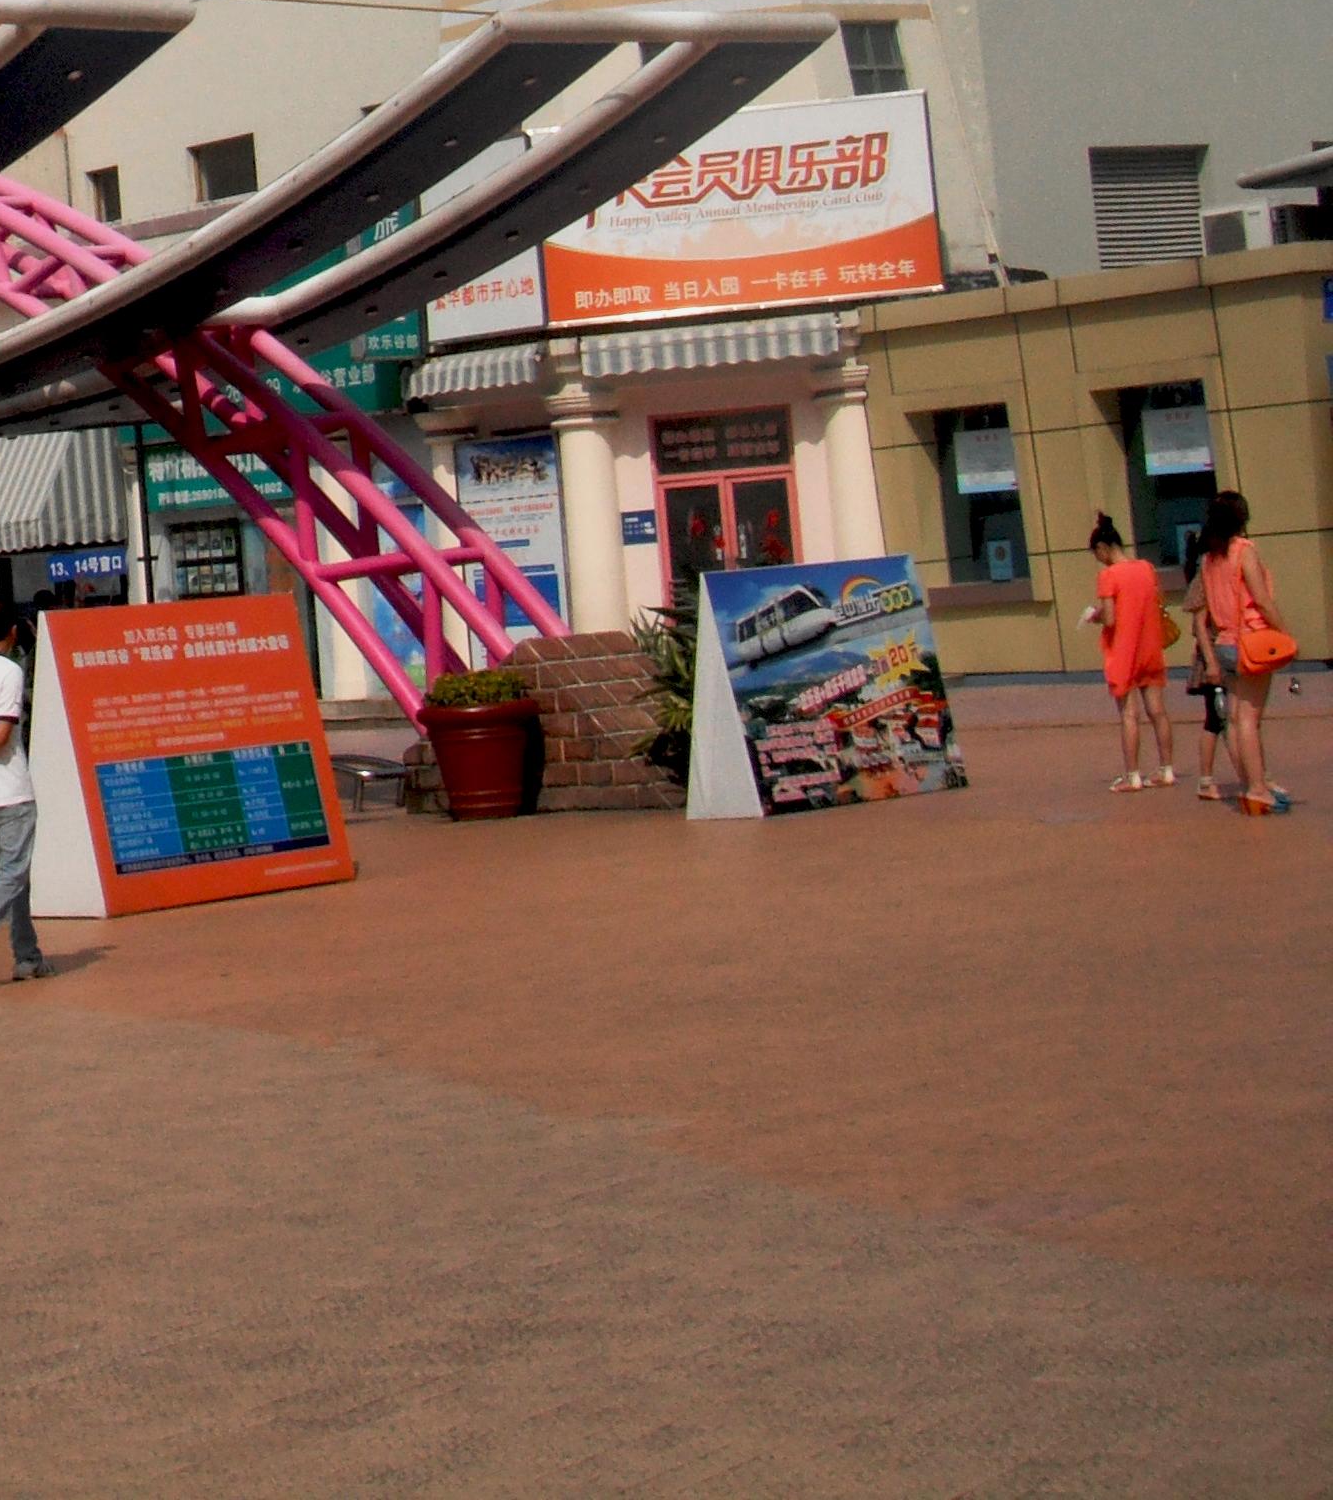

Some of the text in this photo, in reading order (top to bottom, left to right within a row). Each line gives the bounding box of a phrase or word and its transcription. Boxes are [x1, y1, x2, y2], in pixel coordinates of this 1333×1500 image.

[586, 131, 890, 229] 会员俱乐部
[609, 190, 883, 229] Happy Valley Annual Membership Card Club
[575, 258, 916, 309] 即办即取 当日入园 一卡在手 玩转全年
